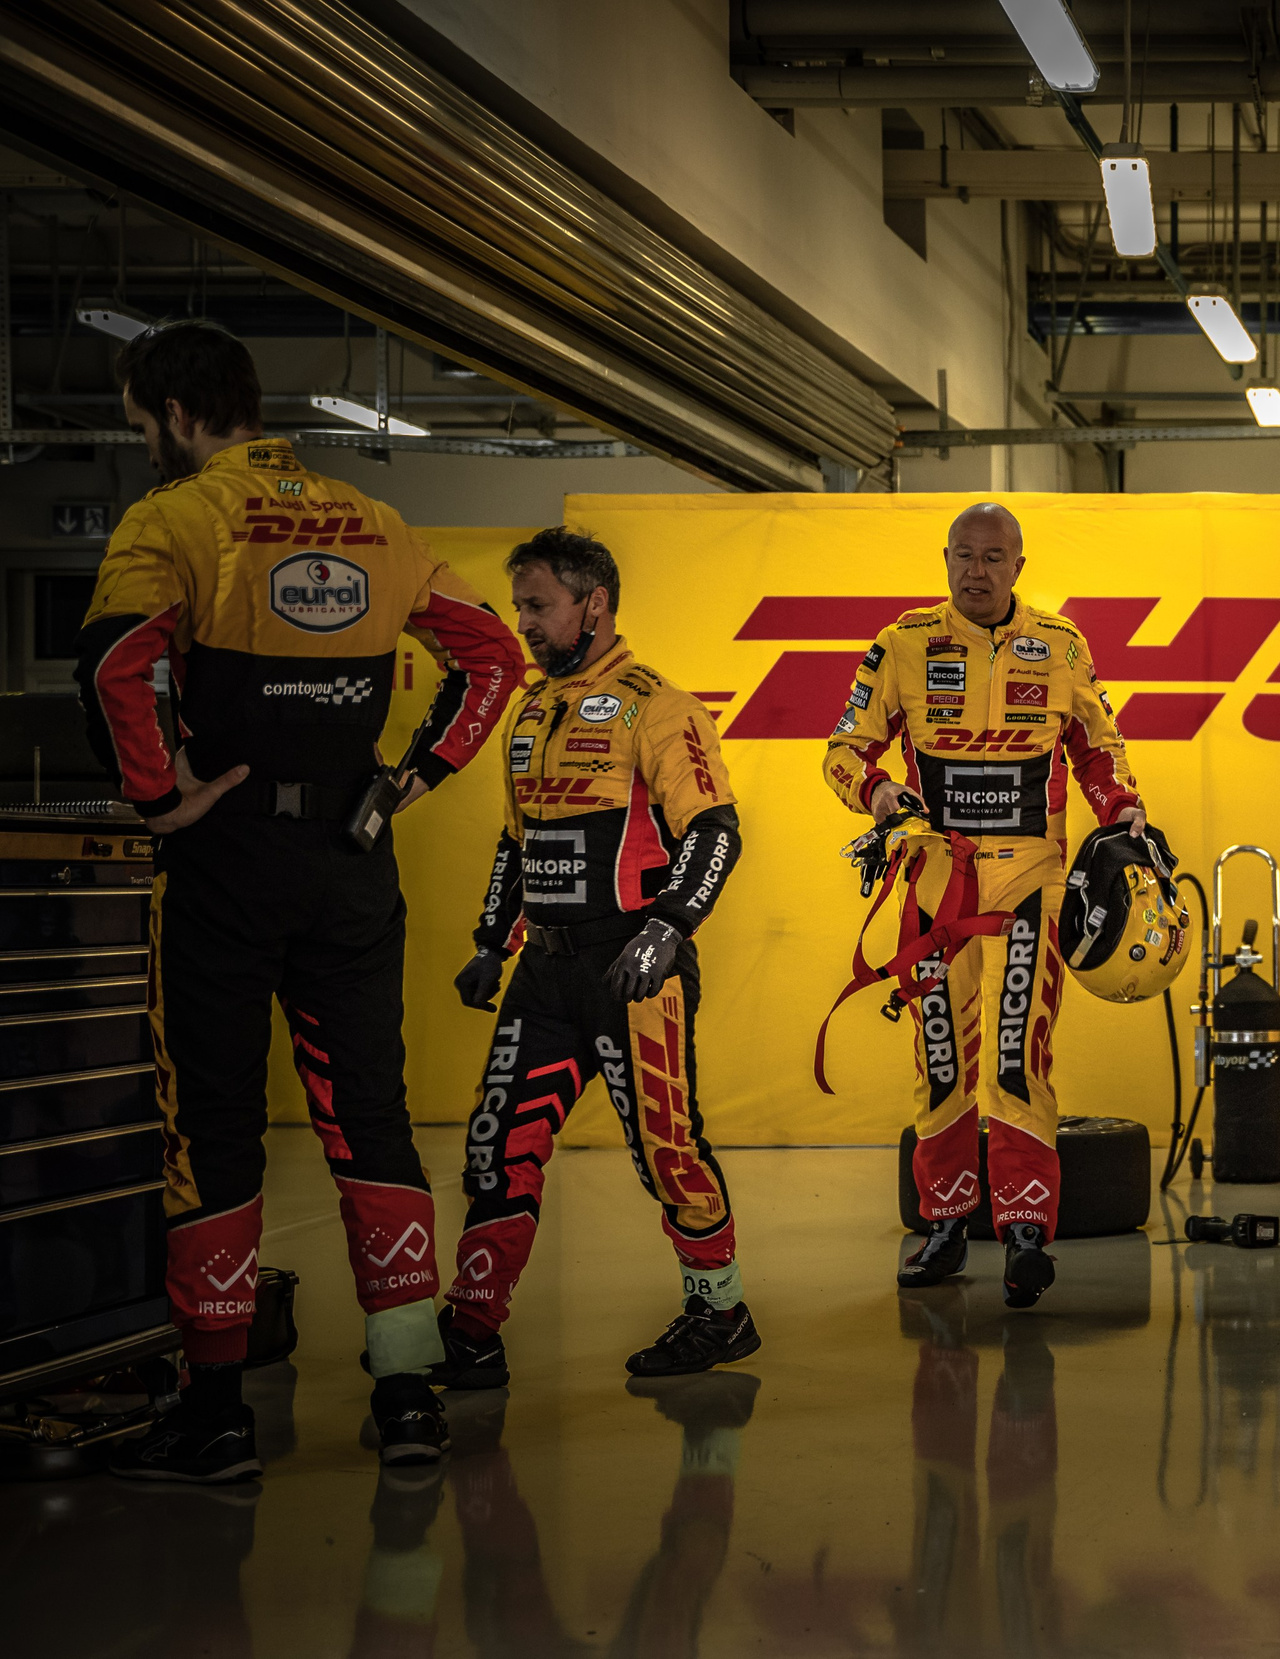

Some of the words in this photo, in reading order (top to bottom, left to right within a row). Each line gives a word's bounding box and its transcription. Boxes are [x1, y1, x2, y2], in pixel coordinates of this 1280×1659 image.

[279, 480, 303, 496] P1
[270, 498, 306, 511] Audi
[310, 500, 357, 513] Sport
[245, 515, 376, 546] DHL
[280, 578, 361, 606] eurol
[927, 671, 965, 680] TRICORP
[263, 681, 334, 697] comtoyou
[583, 703, 617, 713] eurol
[1013, 698, 1043, 706] IRECKONU
[579, 741, 608, 750] IRECKONU
[932, 727, 1034, 752] DHL
[559, 760, 591, 768] comtoyou
[683, 720, 717, 796] DHL
[515, 777, 601, 806] DHL
[944, 789, 1021, 804] TRICORP
[522, 858, 588, 875] TRICORP
[685, 831, 729, 911] TRICORP
[639, 944, 656, 974] HyFlex
[998, 916, 1037, 1075] TRICORP
[466, 1018, 524, 1192] TRICORP
[638, 1017, 718, 1206] DHL
[931, 1195, 980, 1217] IRECKONU
[996, 1210, 1049, 1223] IRECKONU
[366, 1269, 435, 1293] IRECKONU
[684, 1275, 712, 1295] 08
[198, 1301, 258, 1315] IRECKO
[727, 1312, 750, 1345] salomon
